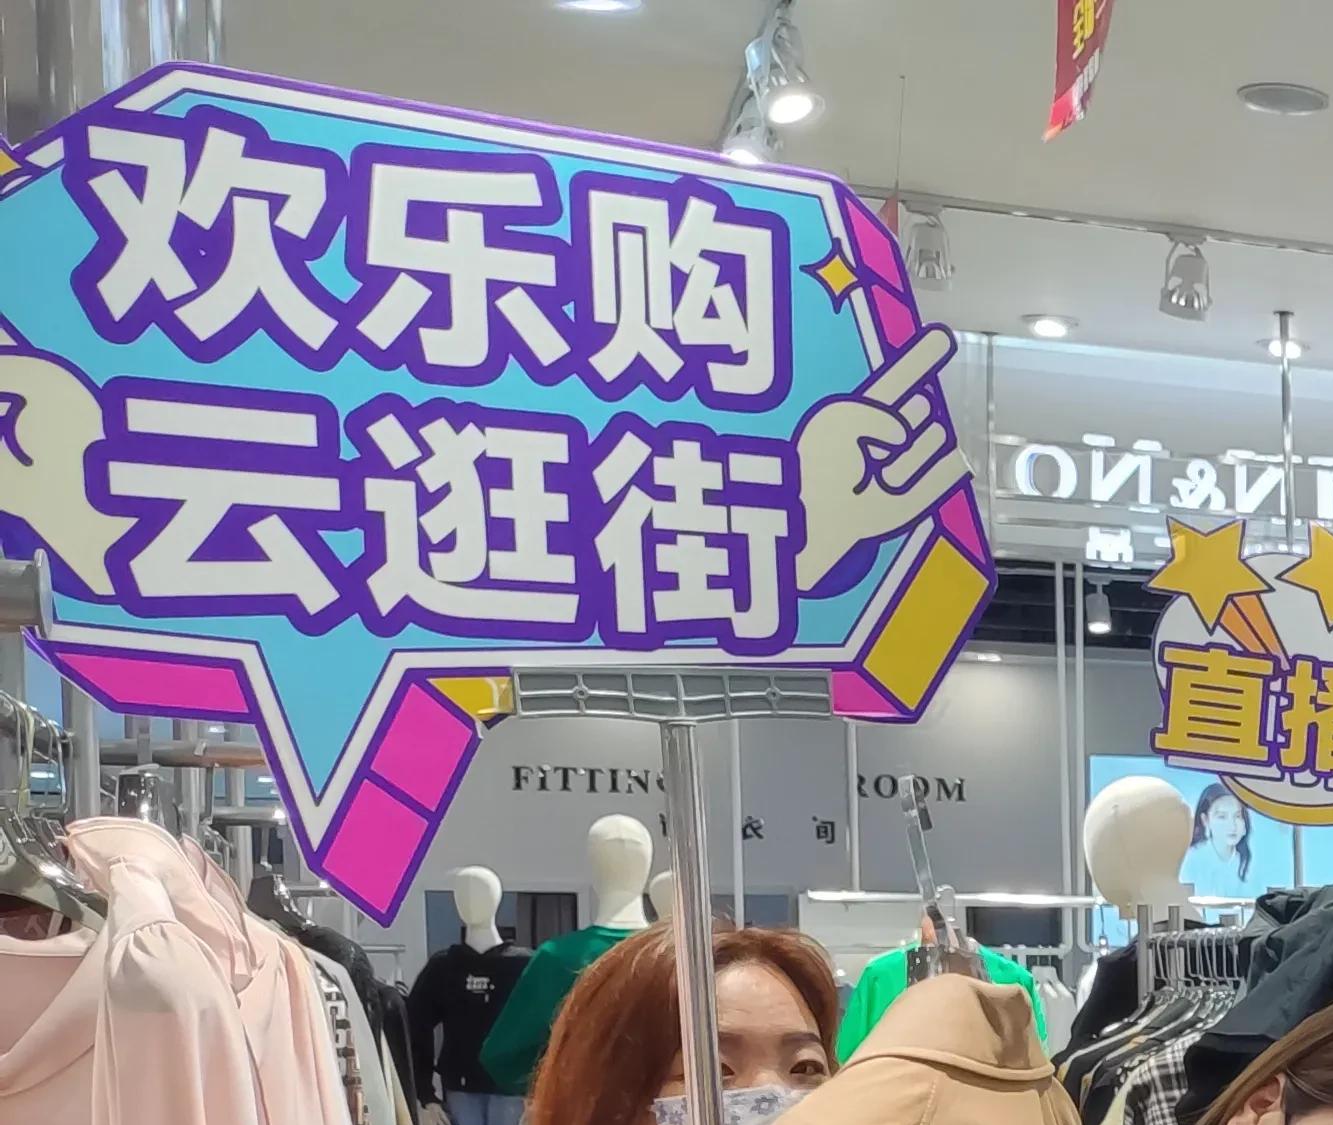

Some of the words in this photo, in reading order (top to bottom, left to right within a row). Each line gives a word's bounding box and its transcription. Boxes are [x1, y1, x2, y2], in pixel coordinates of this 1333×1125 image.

[88, 126, 776, 397] 欢乐购
[108, 397, 788, 640] 云逛街
